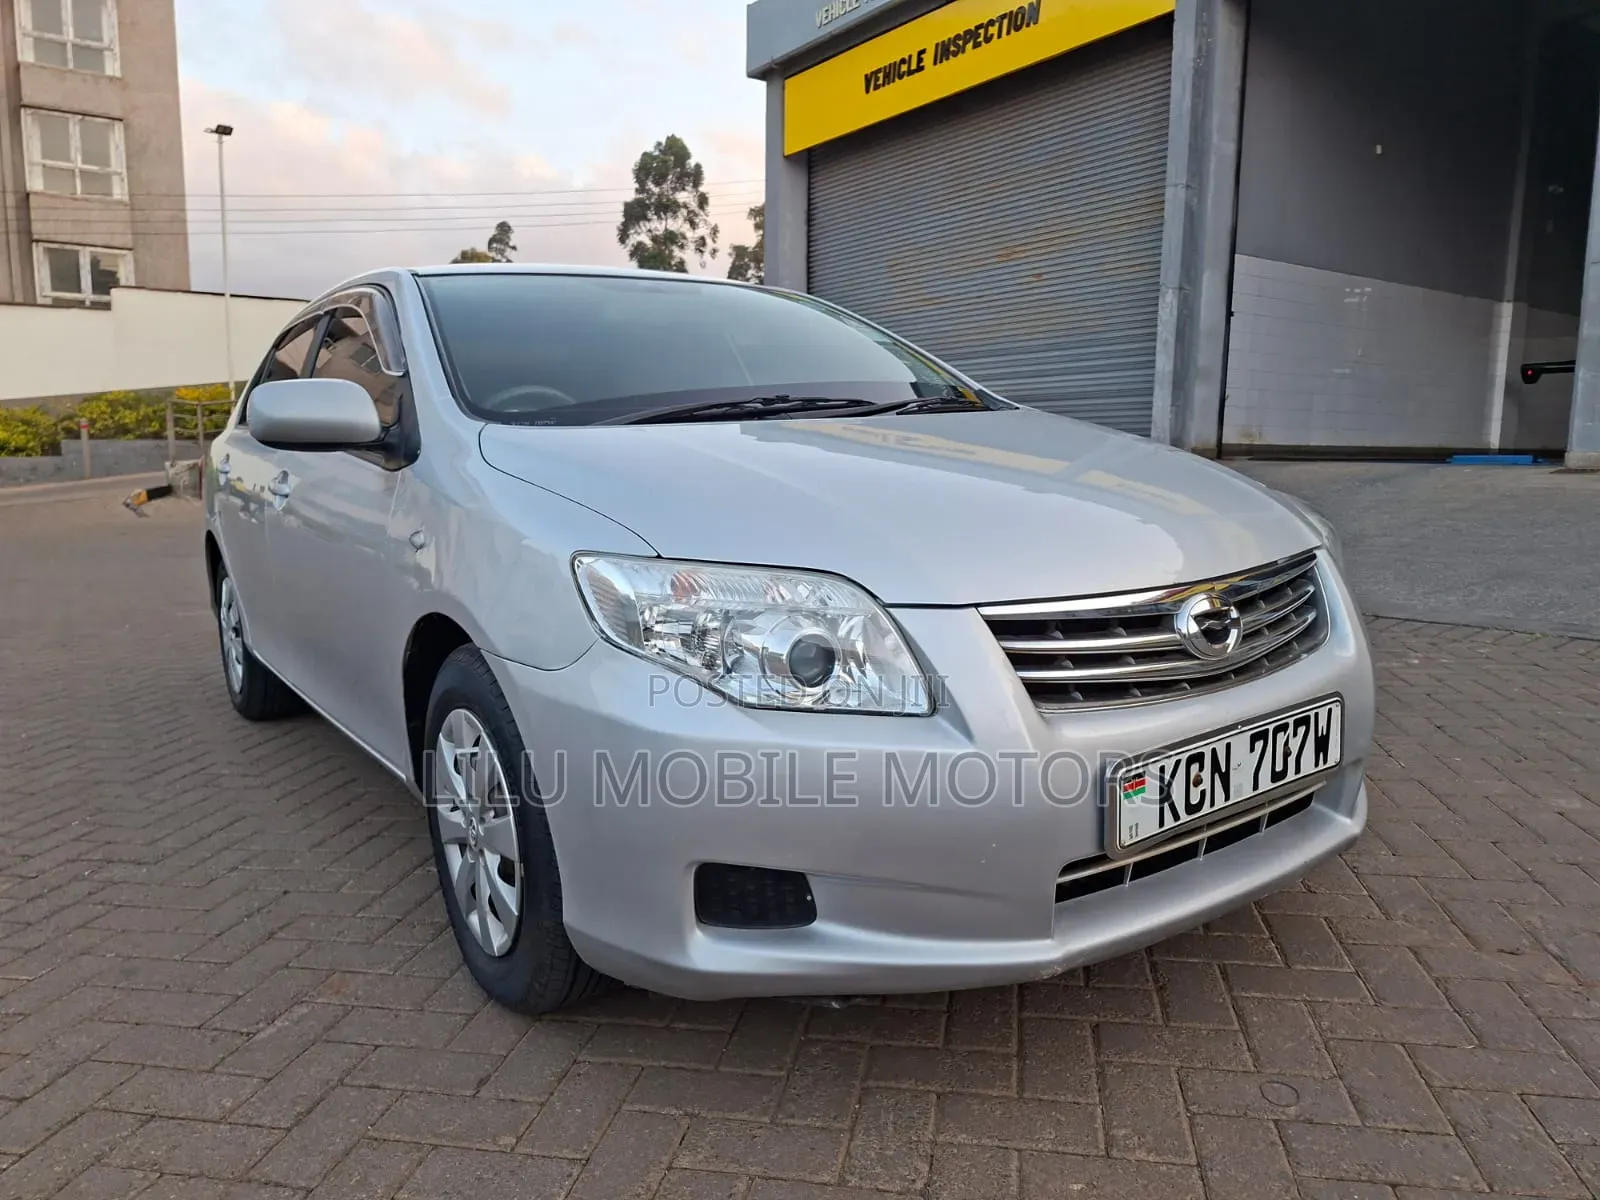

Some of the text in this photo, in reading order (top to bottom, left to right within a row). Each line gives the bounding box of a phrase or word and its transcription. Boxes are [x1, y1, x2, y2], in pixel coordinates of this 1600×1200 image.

[864, 0, 1041, 95] VEHICLE INSPECTION
[1158, 707, 1333, 829] KCN 707W
